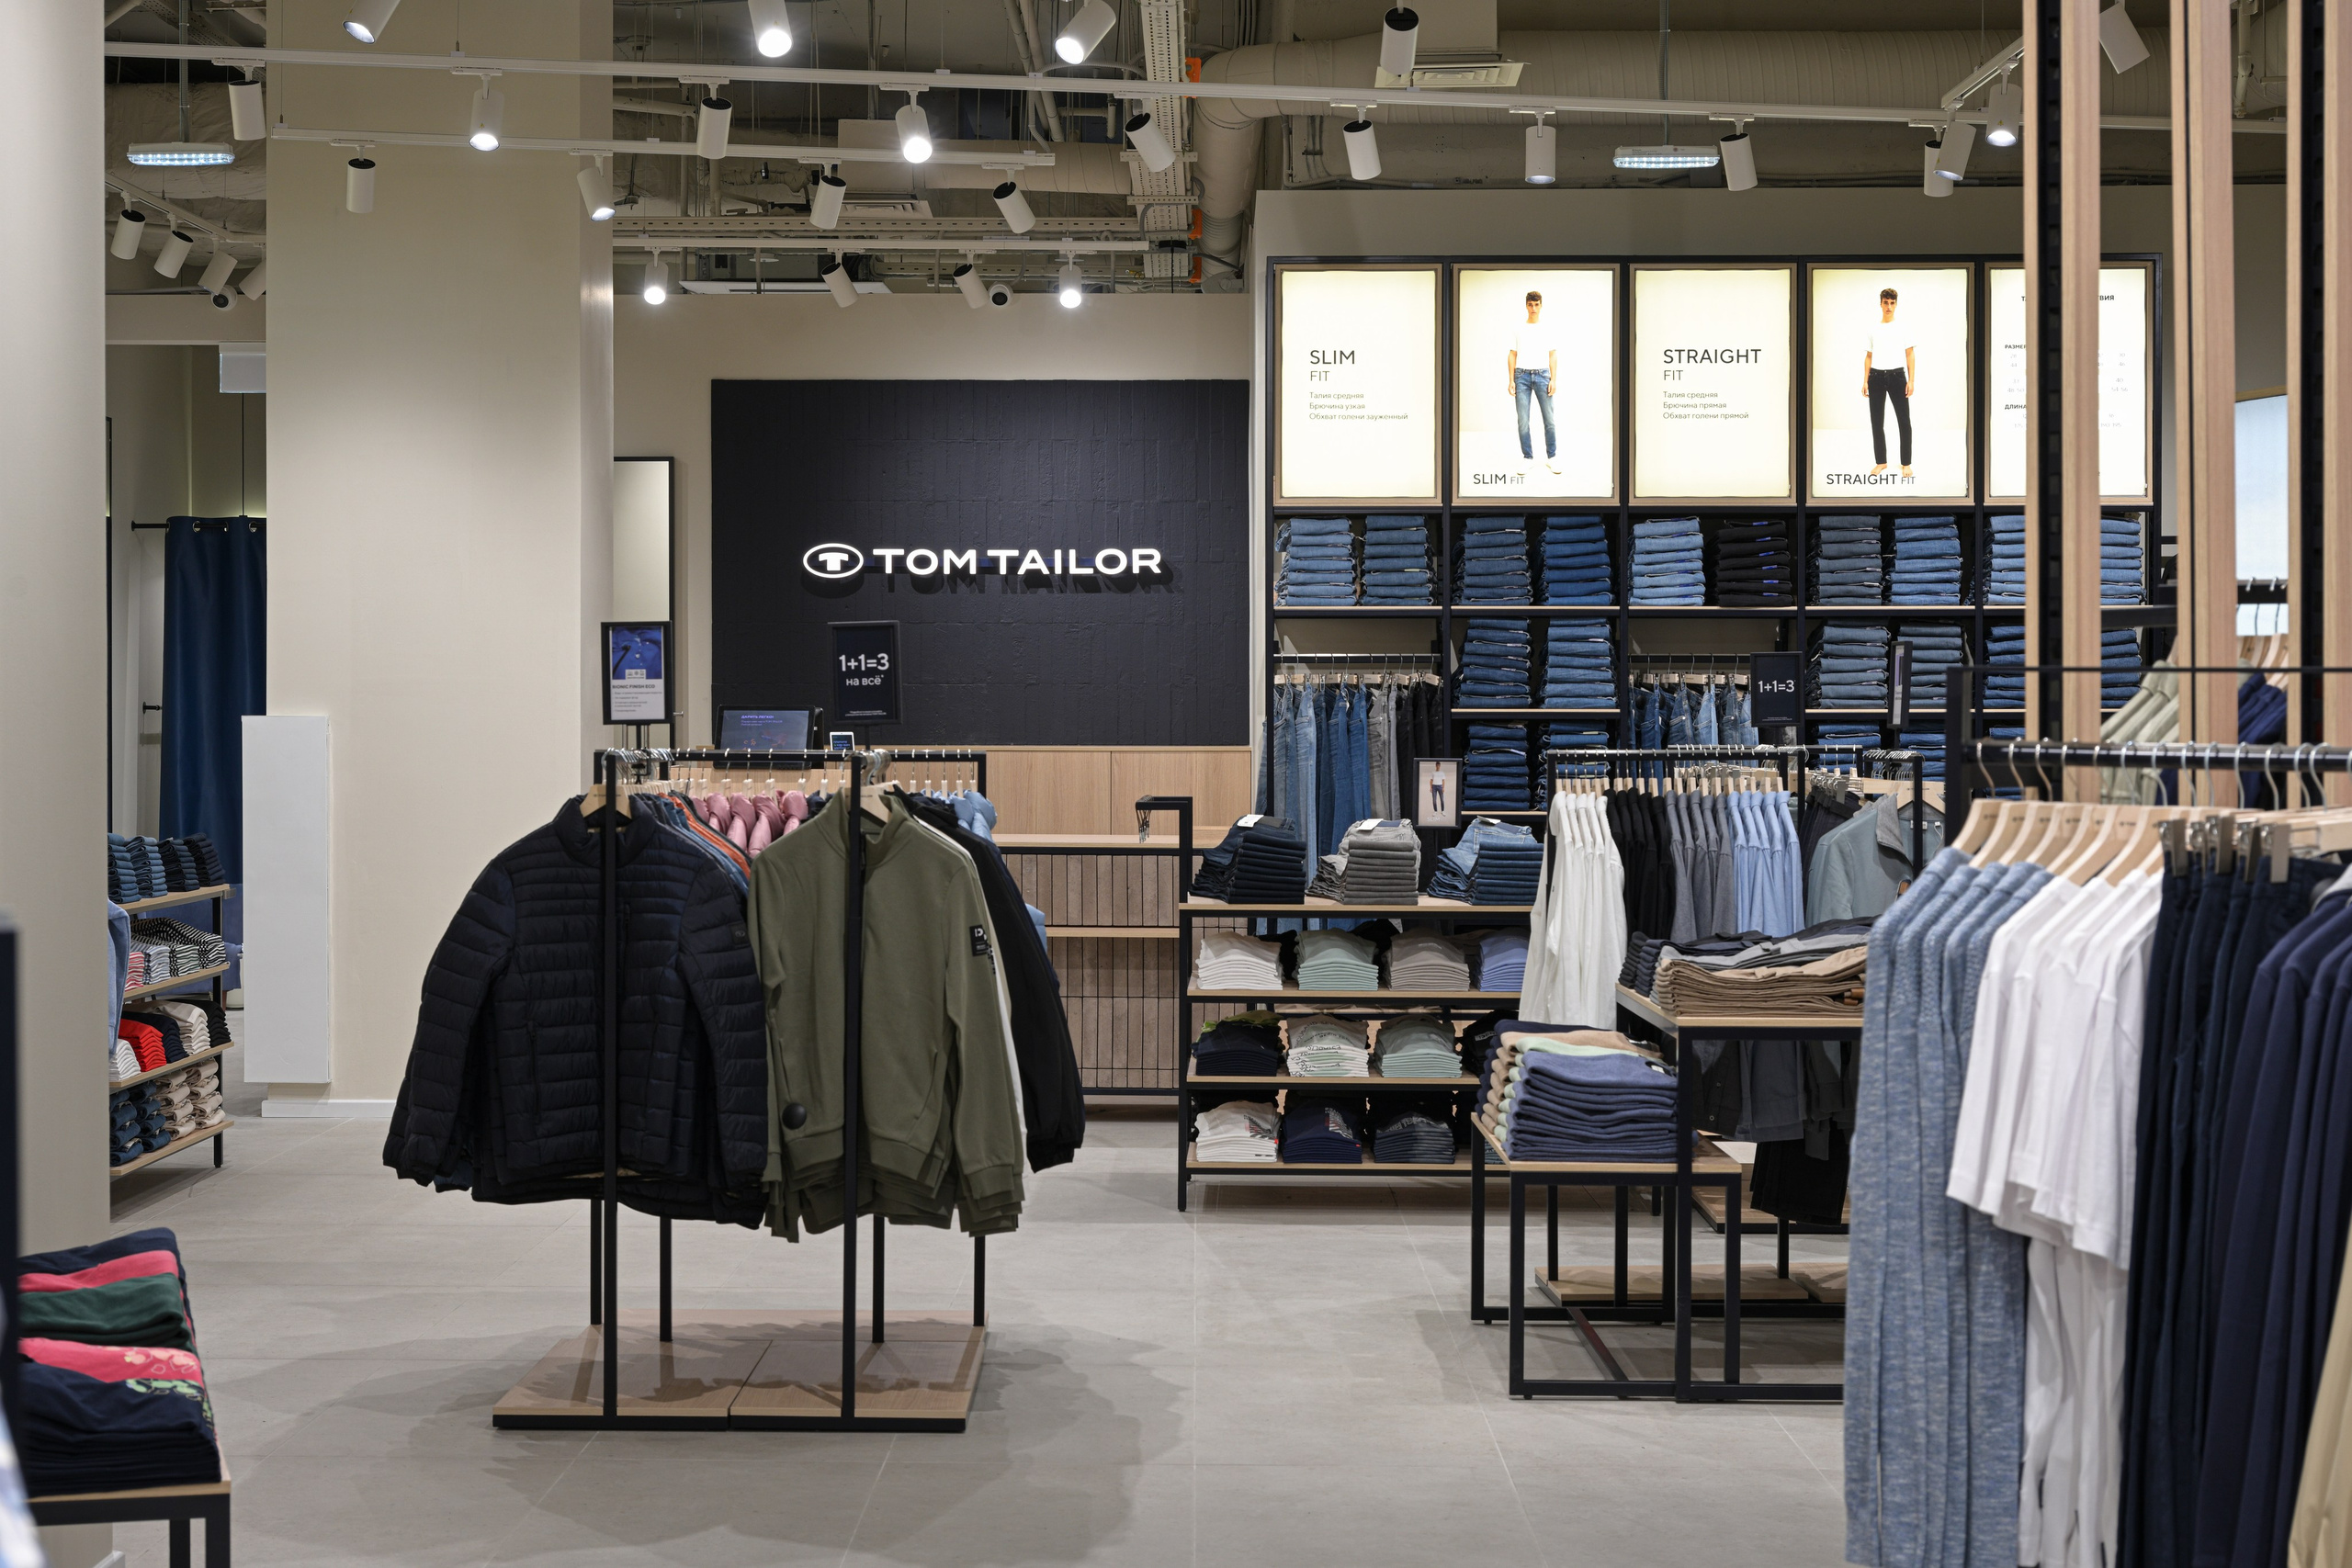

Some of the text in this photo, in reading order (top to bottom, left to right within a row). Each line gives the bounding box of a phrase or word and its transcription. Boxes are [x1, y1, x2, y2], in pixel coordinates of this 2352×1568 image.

[1310, 350, 1355, 365] SLIM
[1664, 349, 1762, 364] STRAIGHT
[1310, 370, 1330, 381] FIT
[1664, 369, 1683, 380] FIT
[1309, 402, 1343, 411] Брючина
[1663, 401, 1698, 410] Брючина
[1366, 412, 1408, 421] зауженный
[1720, 412, 1749, 420] прямой
[1473, 473, 1525, 484] SLIM FIT
[1826, 474, 1916, 485] STRAIGHT FIT
[872, 548, 977, 576] TOM
[987, 548, 1162, 576] TAILOR
[838, 653, 889, 671] 1+1=3
[845, 678, 859, 686] на
